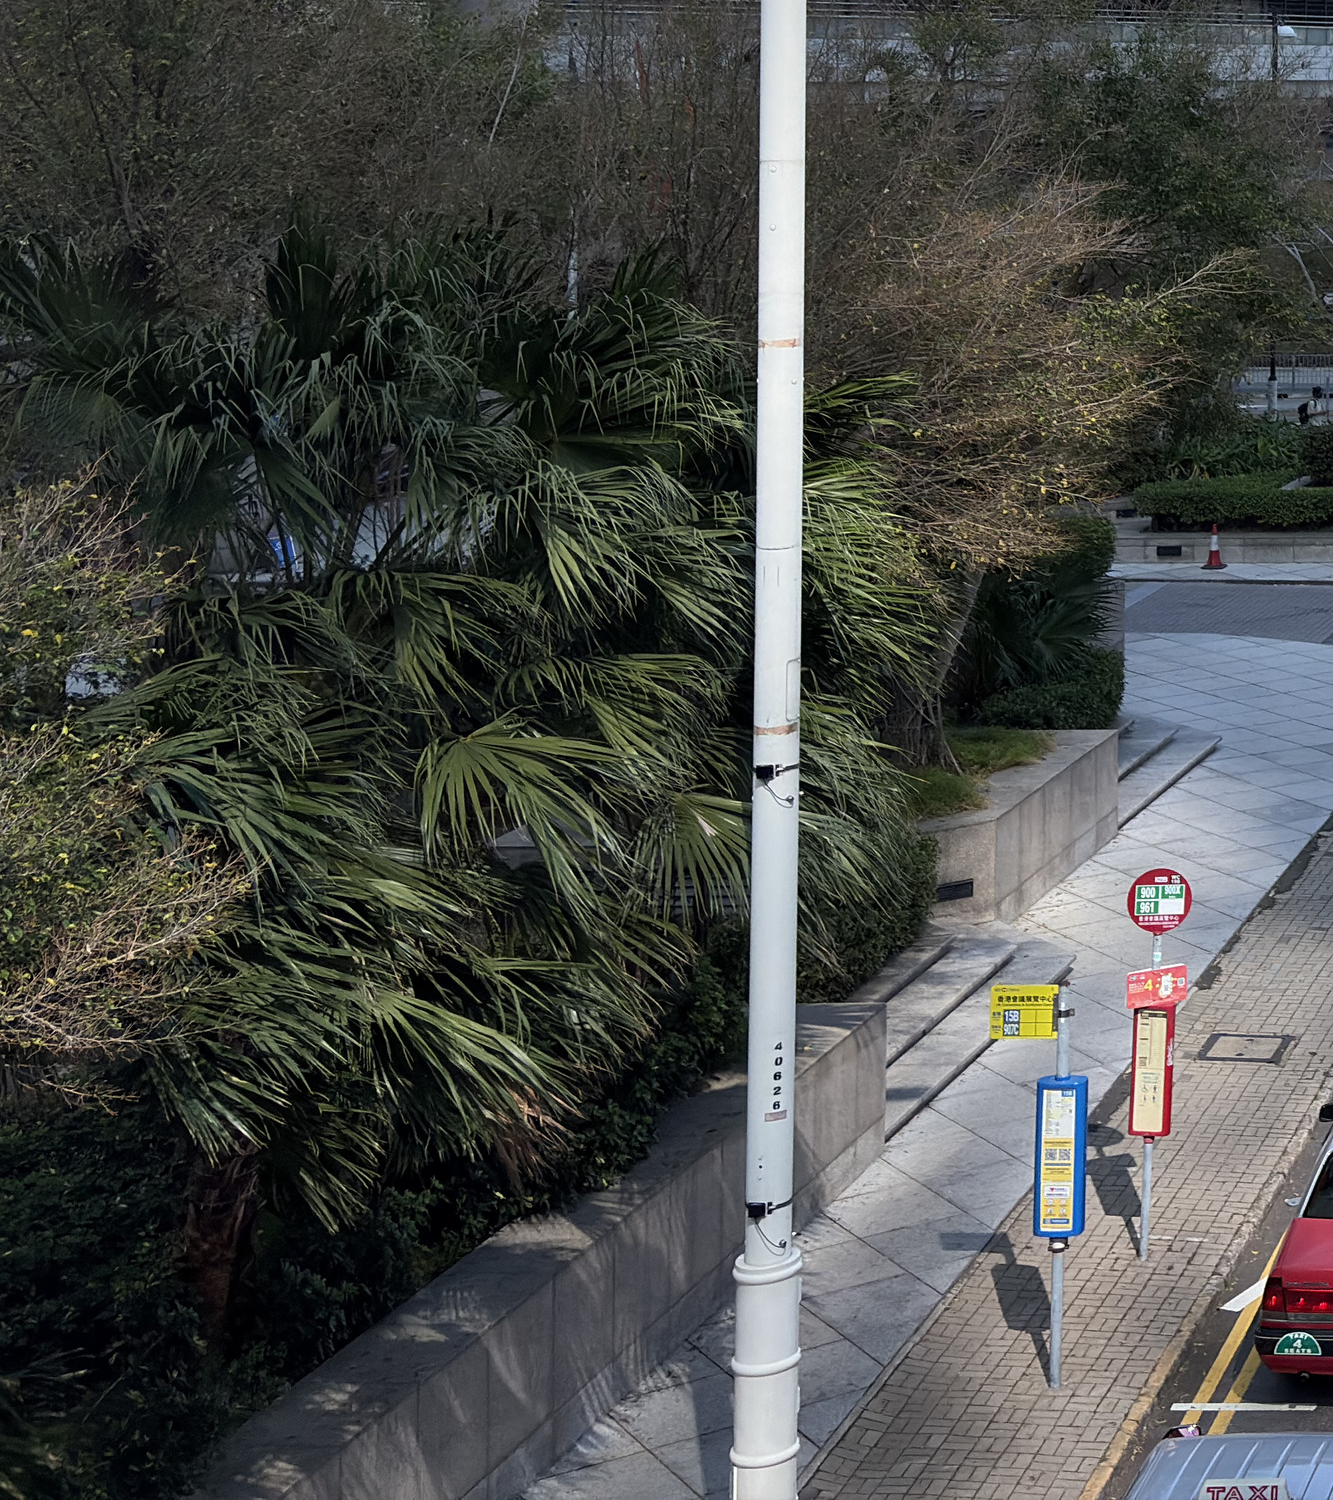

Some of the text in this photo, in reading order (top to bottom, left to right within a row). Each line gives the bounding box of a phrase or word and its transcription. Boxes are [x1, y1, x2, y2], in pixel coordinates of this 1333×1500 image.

[1141, 885, 1181, 898] 900 900X
[1140, 902, 1154, 913] 961
[1004, 1010, 1019, 1022] 15B
[1293, 1340, 1302, 1349] 4
[1206, 1485, 1278, 1500] TAXI
